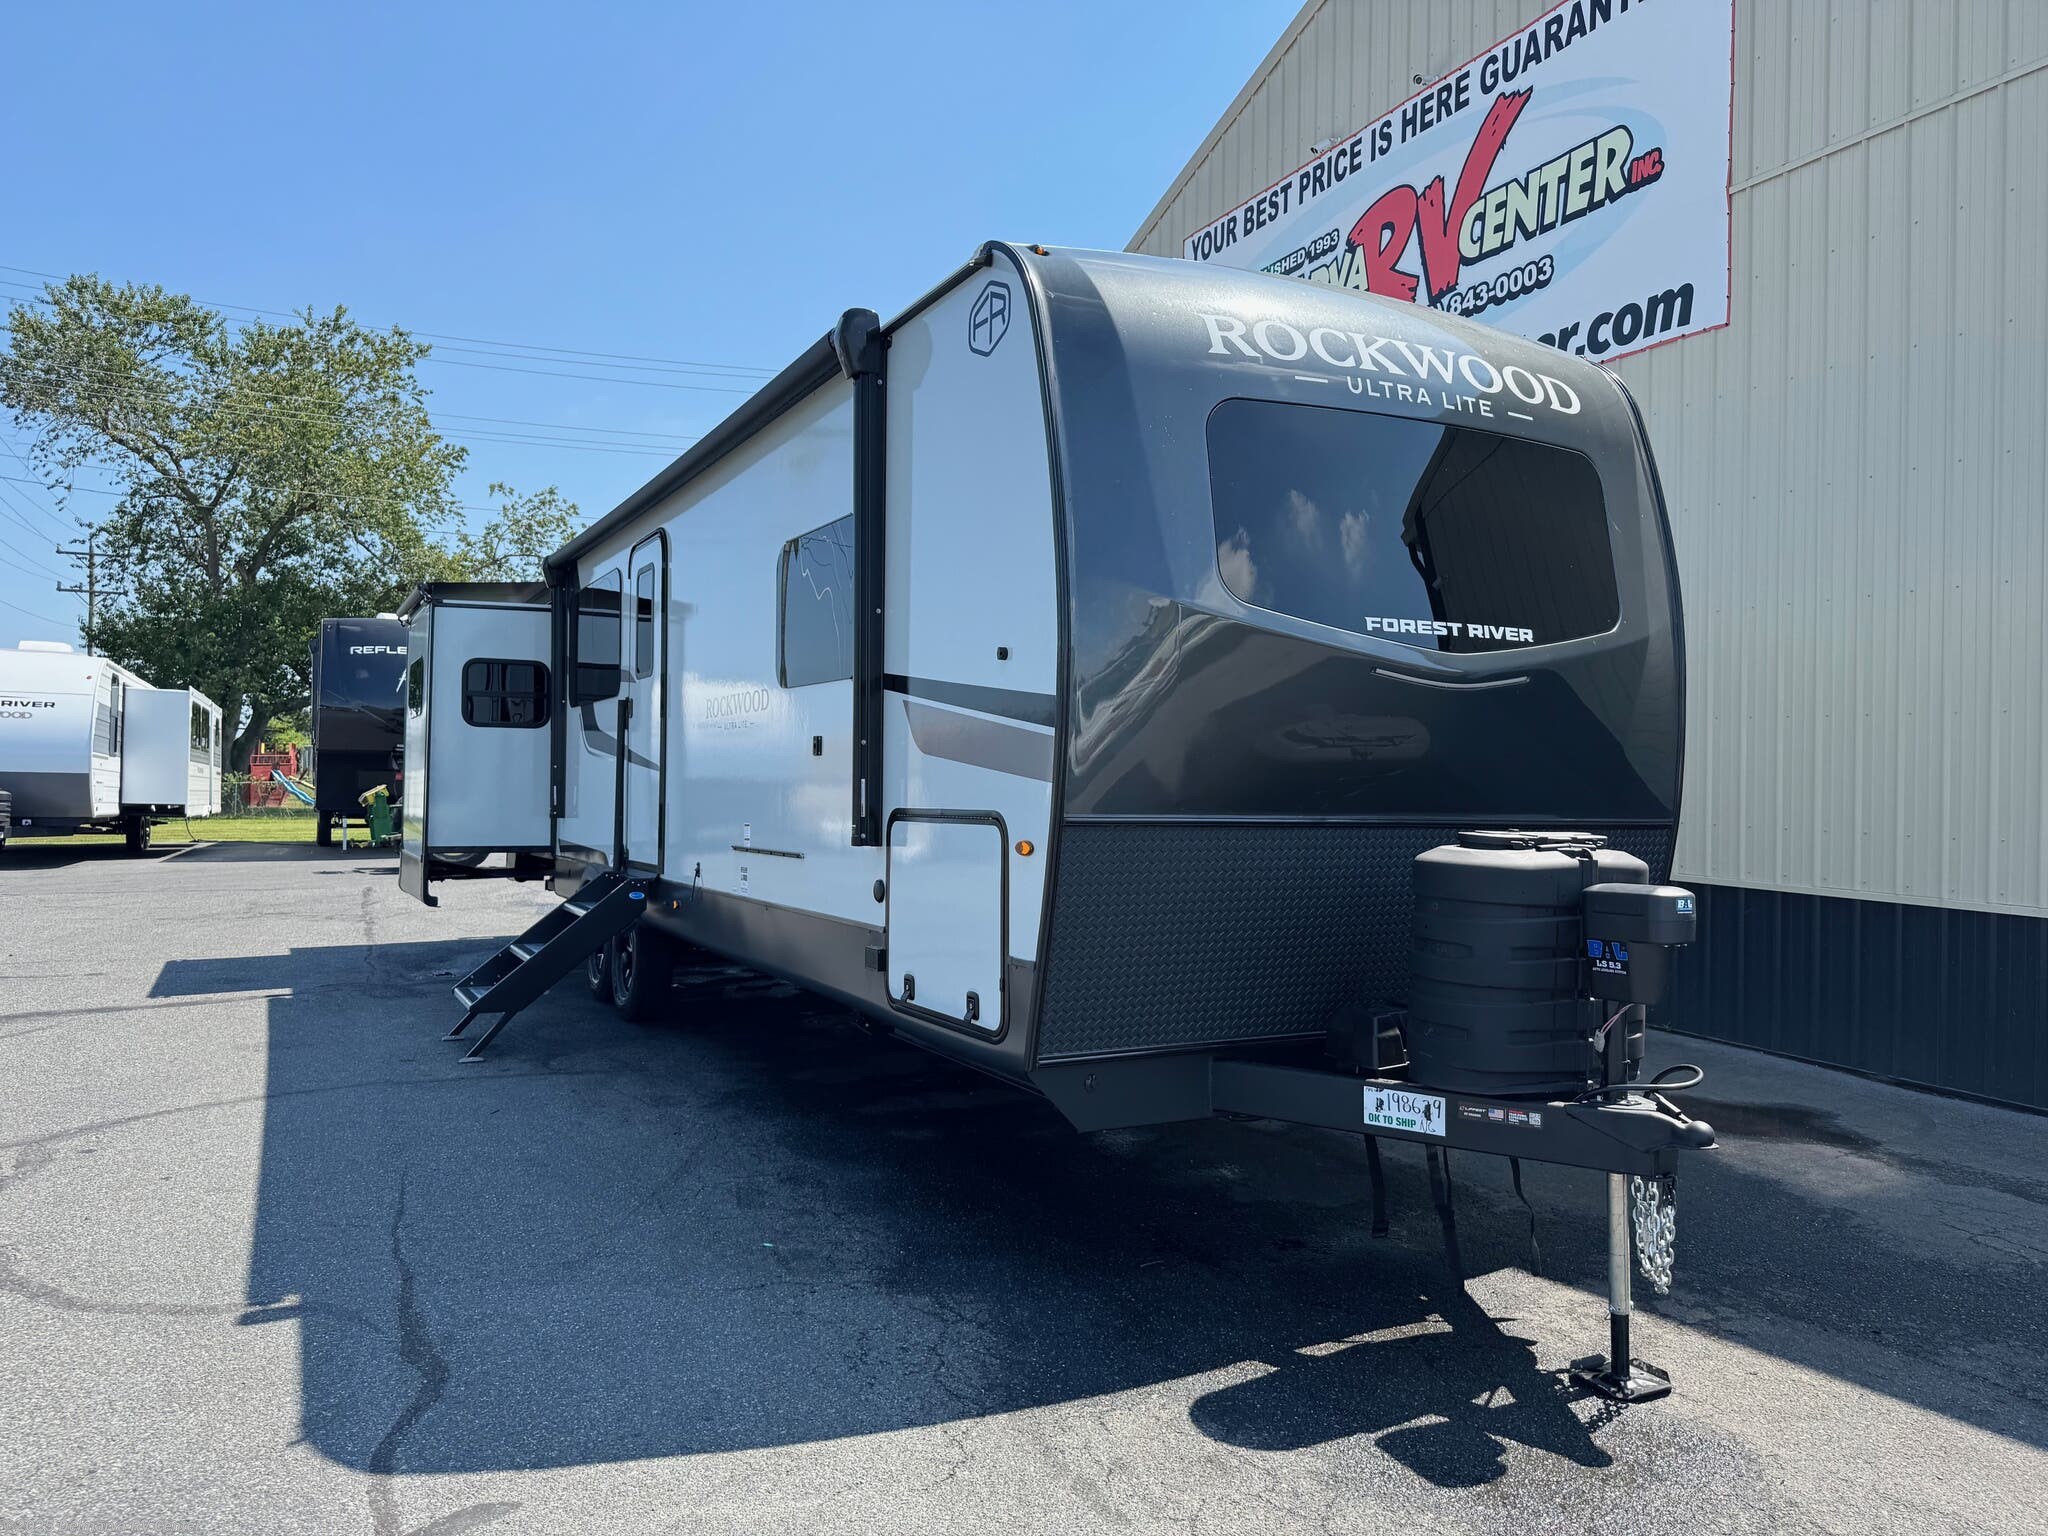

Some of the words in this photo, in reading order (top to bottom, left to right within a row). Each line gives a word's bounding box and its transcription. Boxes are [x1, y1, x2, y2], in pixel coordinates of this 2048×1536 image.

[1191, 215, 1238, 261] YOUR
[1243, 181, 1293, 237] BEST
[1299, 136, 1362, 205] PRICE
[1370, 119, 1393, 163] IS
[1401, 83, 1470, 144] HERE
[1346, 85, 1534, 304] RV
[1459, 126, 1633, 264] CENTER
[1630, 150, 1663, 187] INC.
[1309, 230, 1338, 257] 1993
[1448, 256, 1553, 316] 843-0003
[1201, 313, 1582, 415] ROCKWOOD
[1346, 375, 1433, 407] ULTRA
[1441, 391, 1495, 418] LITE
[1364, 616, 1462, 637] FOREST
[1466, 623, 1534, 643] RIVER
[350, 645, 408, 655] REFLE
[0, 711, 33, 719] OOD
[1, 700, 56, 708] RIVER
[704, 688, 770, 720] ROCKWOOD
[1596, 959, 1608, 968] LS
[1368, 1112, 1381, 1123] OK
[1382, 1114, 1394, 1125] TO
[1395, 1116, 1417, 1129] SHIP
